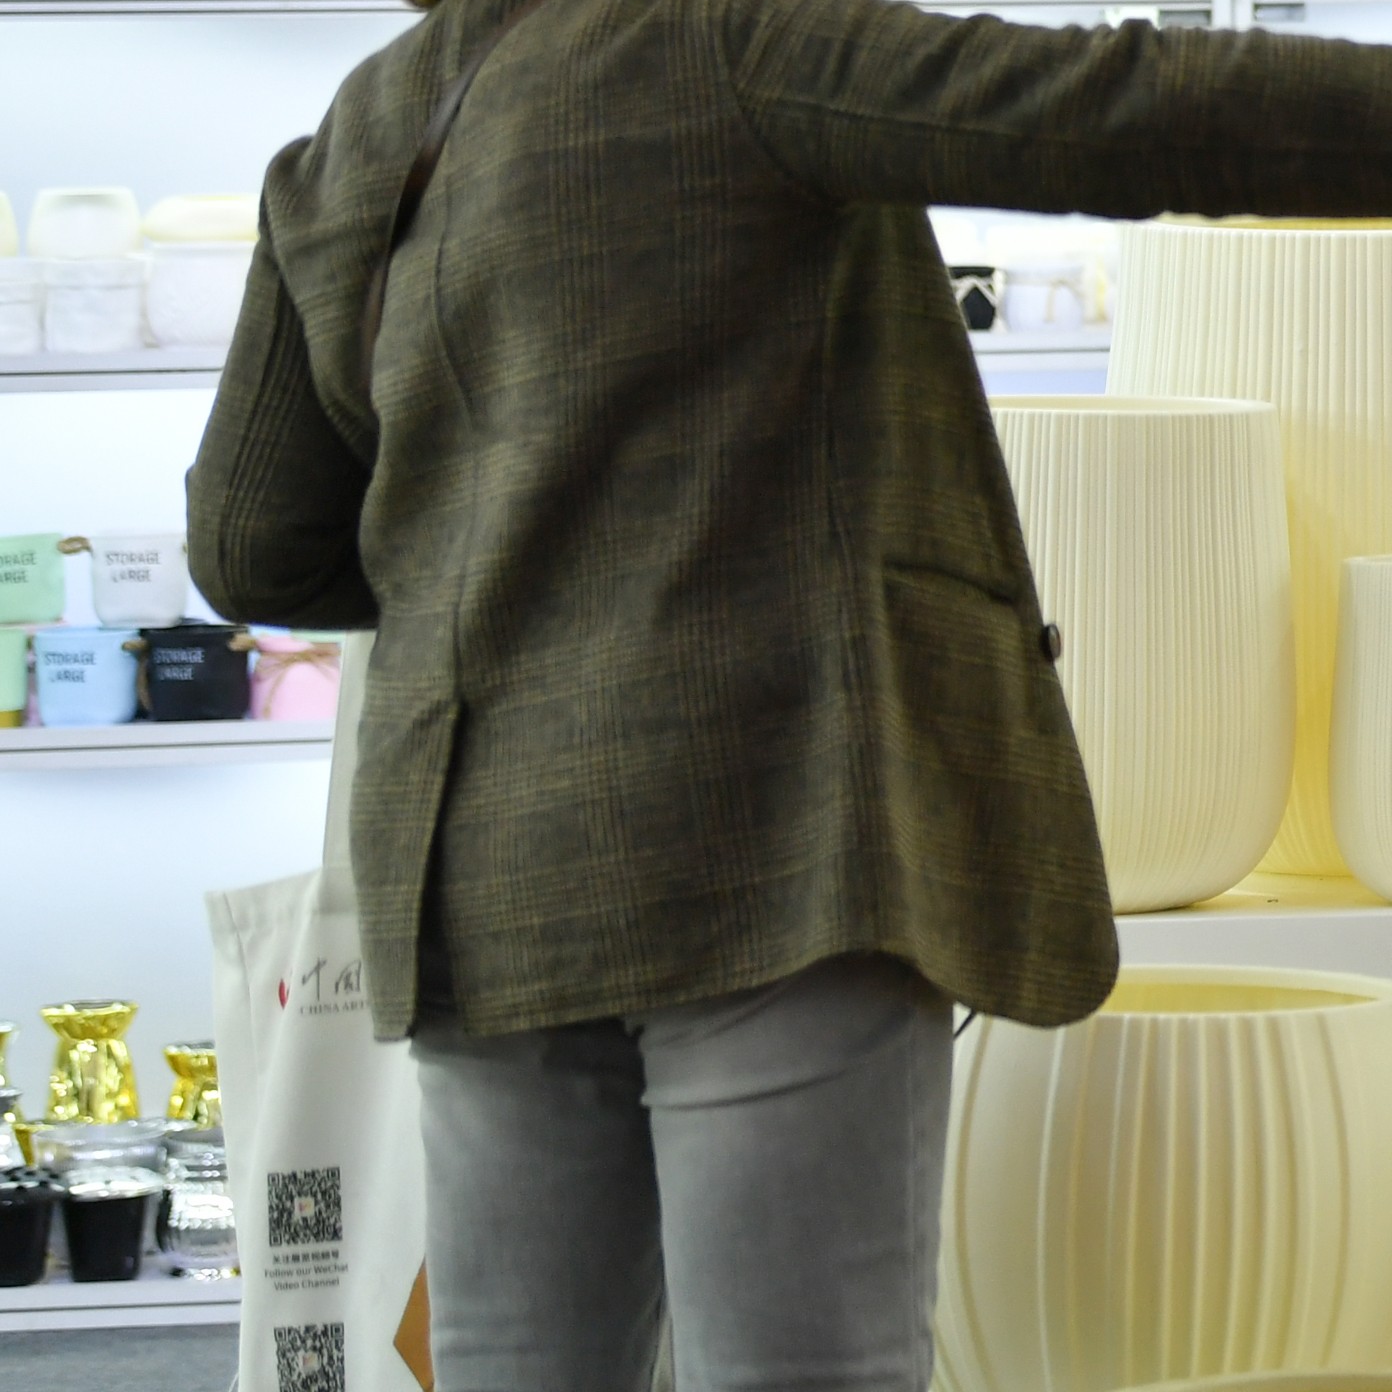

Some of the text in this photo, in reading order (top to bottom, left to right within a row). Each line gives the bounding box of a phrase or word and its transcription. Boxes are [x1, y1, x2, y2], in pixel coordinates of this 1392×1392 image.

[0, 552, 36, 566] ORAGE
[106, 552, 161, 566] STORAGE
[0, 569, 28, 584] ARGE
[112, 569, 152, 583] LARGE
[45, 651, 97, 666] STORAGE
[153, 649, 205, 664] STORAGE
[50, 670, 87, 683] LARGE
[264, 1263, 349, 1278] Follow our WeChat
[273, 1277, 340, 1291] Video Channel
